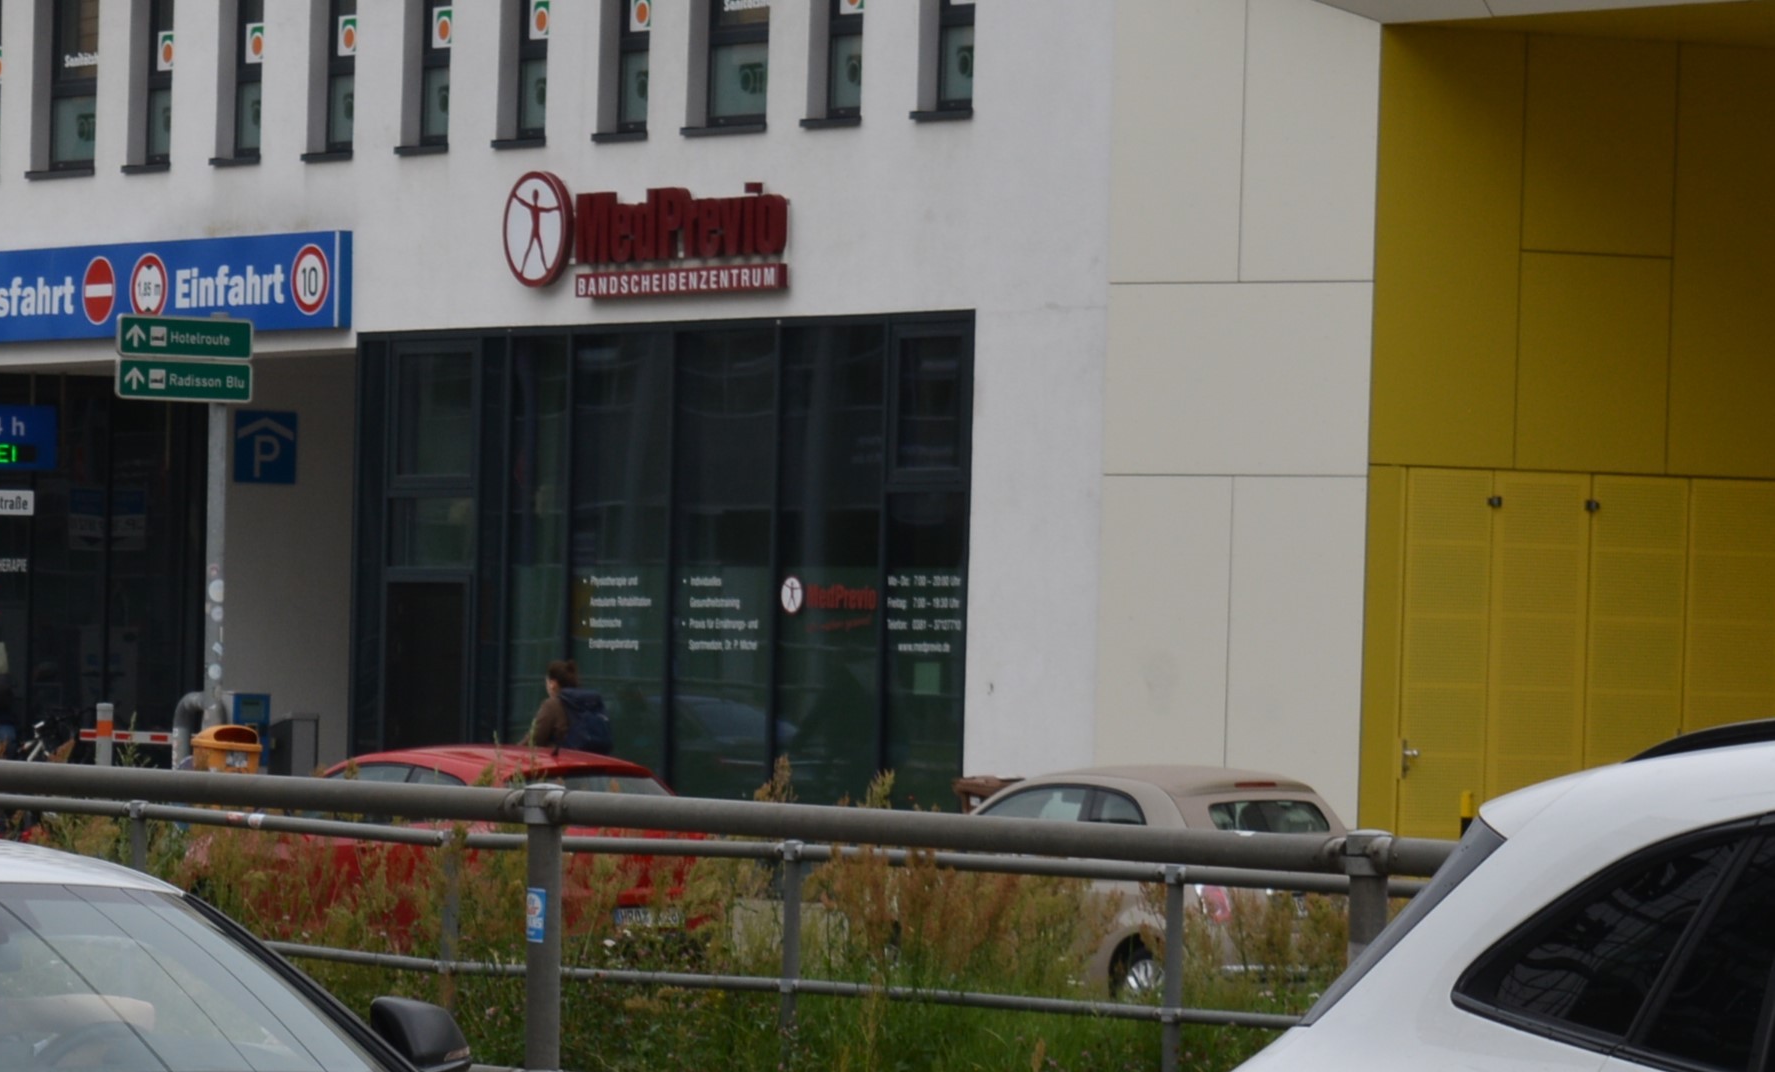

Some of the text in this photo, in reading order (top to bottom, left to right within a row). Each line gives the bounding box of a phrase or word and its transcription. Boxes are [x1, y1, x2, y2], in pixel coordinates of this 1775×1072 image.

[576, 181, 788, 264] MedPrevio
[175, 264, 285, 309] Einfahrt
[301, 266, 318, 297] 10
[578, 266, 776, 296] BANDSCHEIBENZENTRUM
[169, 331, 231, 346] Hotelroute
[169, 373, 245, 389] Radisson Blu
[12, 416, 26, 436] h
[253, 435, 280, 478] P
[806, 584, 879, 610] MedPrevio
